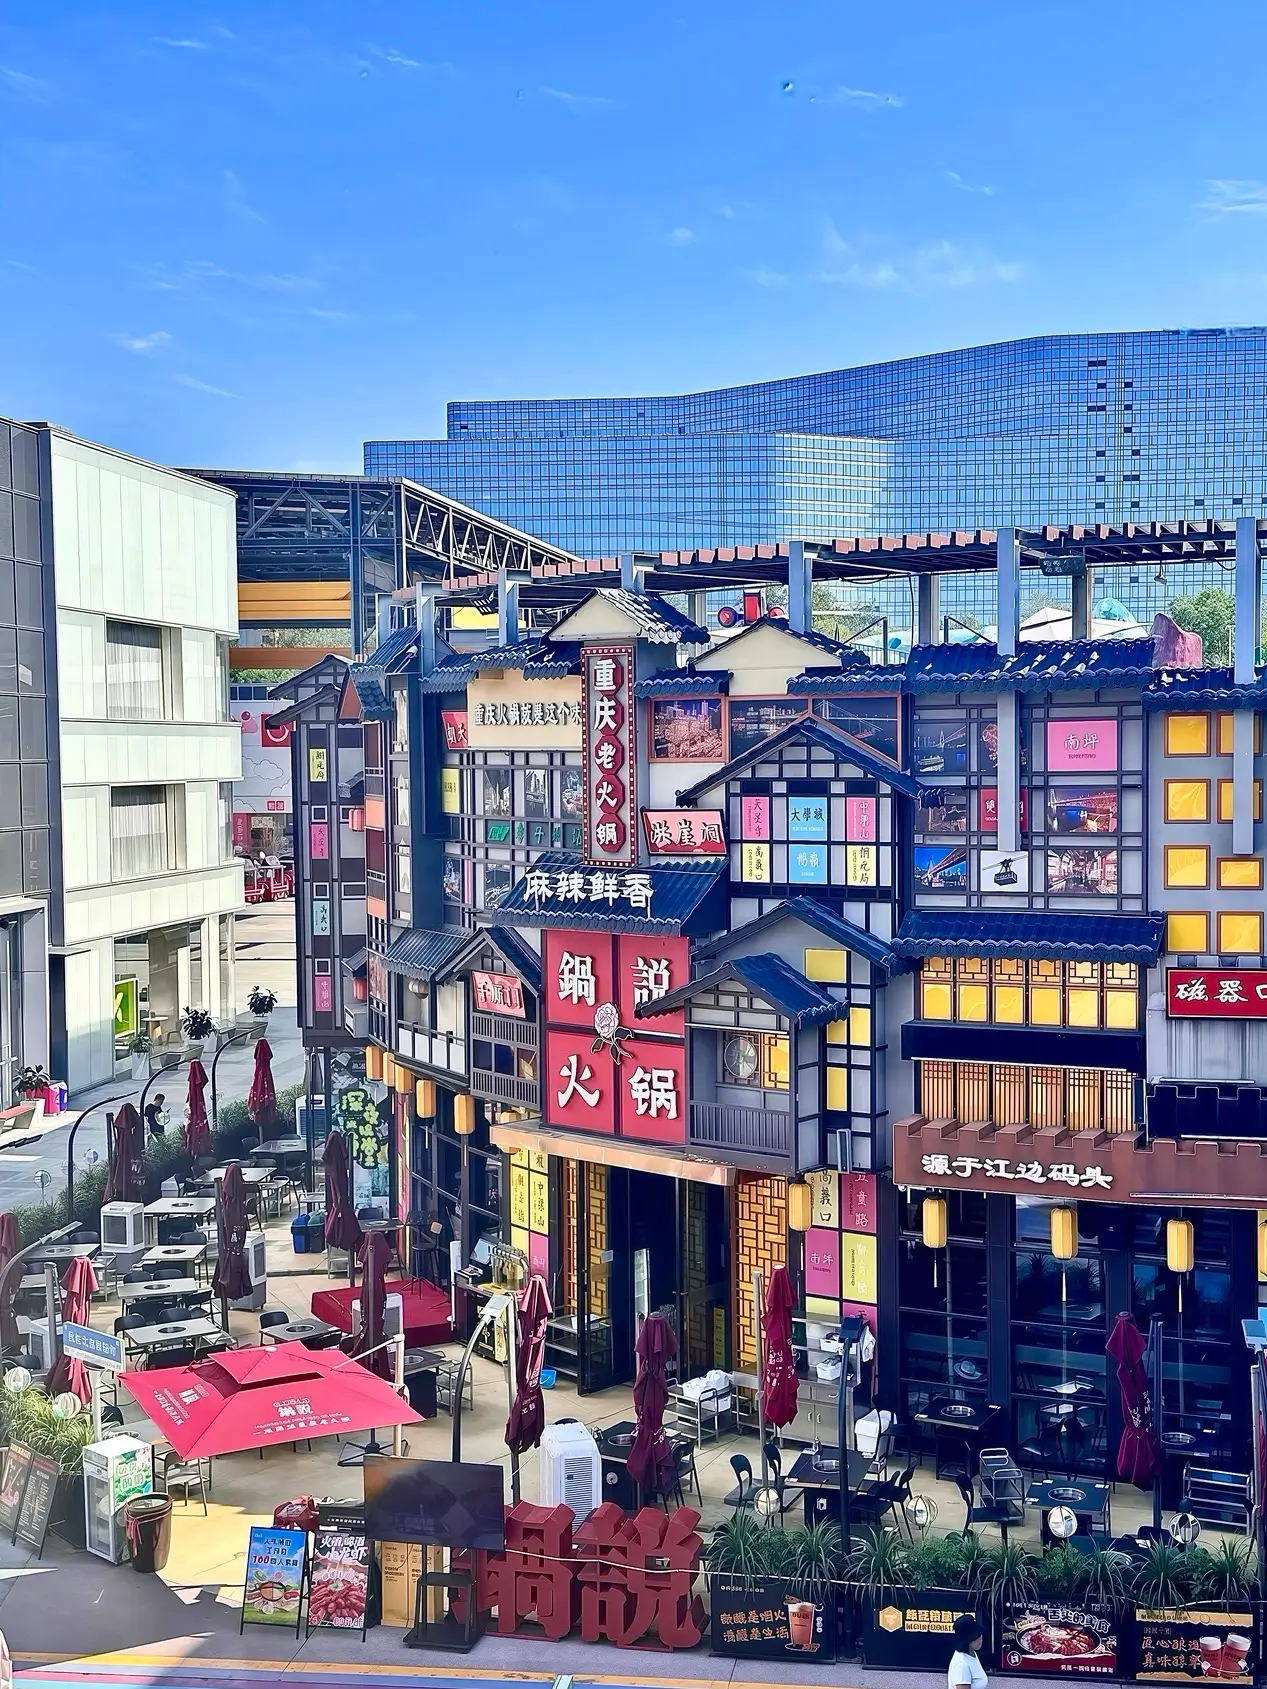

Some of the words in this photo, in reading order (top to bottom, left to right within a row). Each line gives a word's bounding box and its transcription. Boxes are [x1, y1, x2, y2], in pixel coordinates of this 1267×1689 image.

[593, 657, 621, 847] 重庆老火锅
[649, 818, 722, 847] 洪崖洞
[522, 869, 655, 908] 麻辣鲜香
[556, 1053, 679, 1121] 火锅
[920, 1153, 1114, 1190] 源于江边码头
